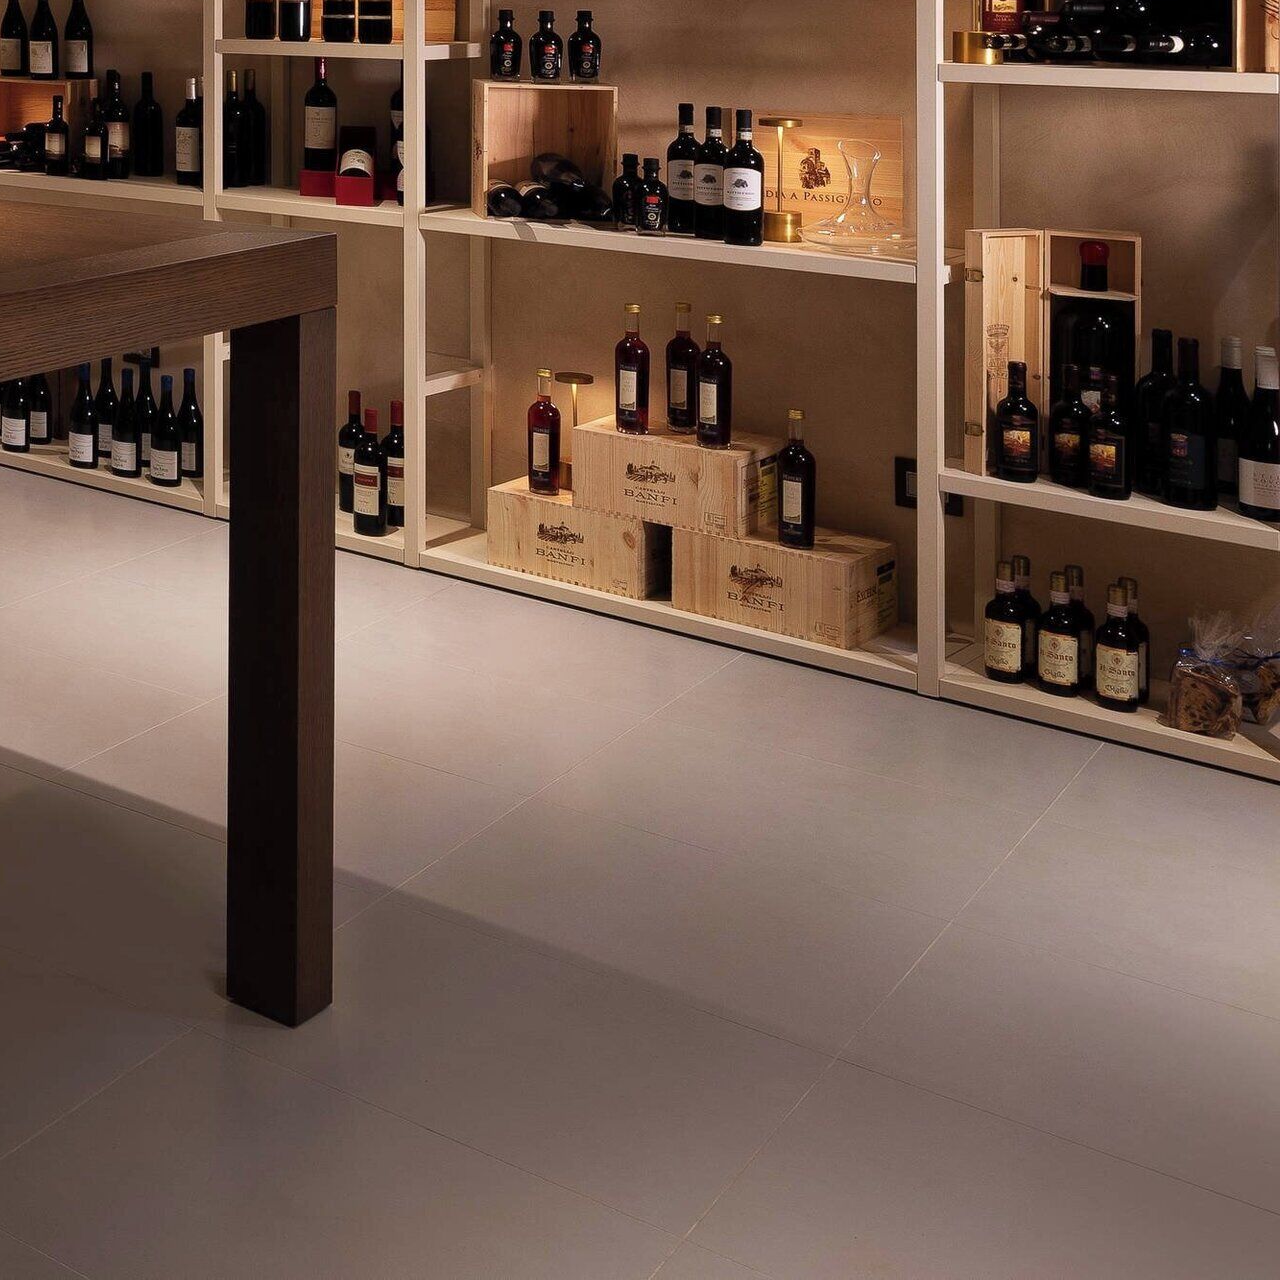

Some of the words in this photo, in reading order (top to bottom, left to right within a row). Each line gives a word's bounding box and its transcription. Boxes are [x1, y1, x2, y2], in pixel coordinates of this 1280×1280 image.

[624, 488, 678, 506] BANFI
[535, 548, 586, 566] BANFI
[726, 591, 785, 612] BANFI
